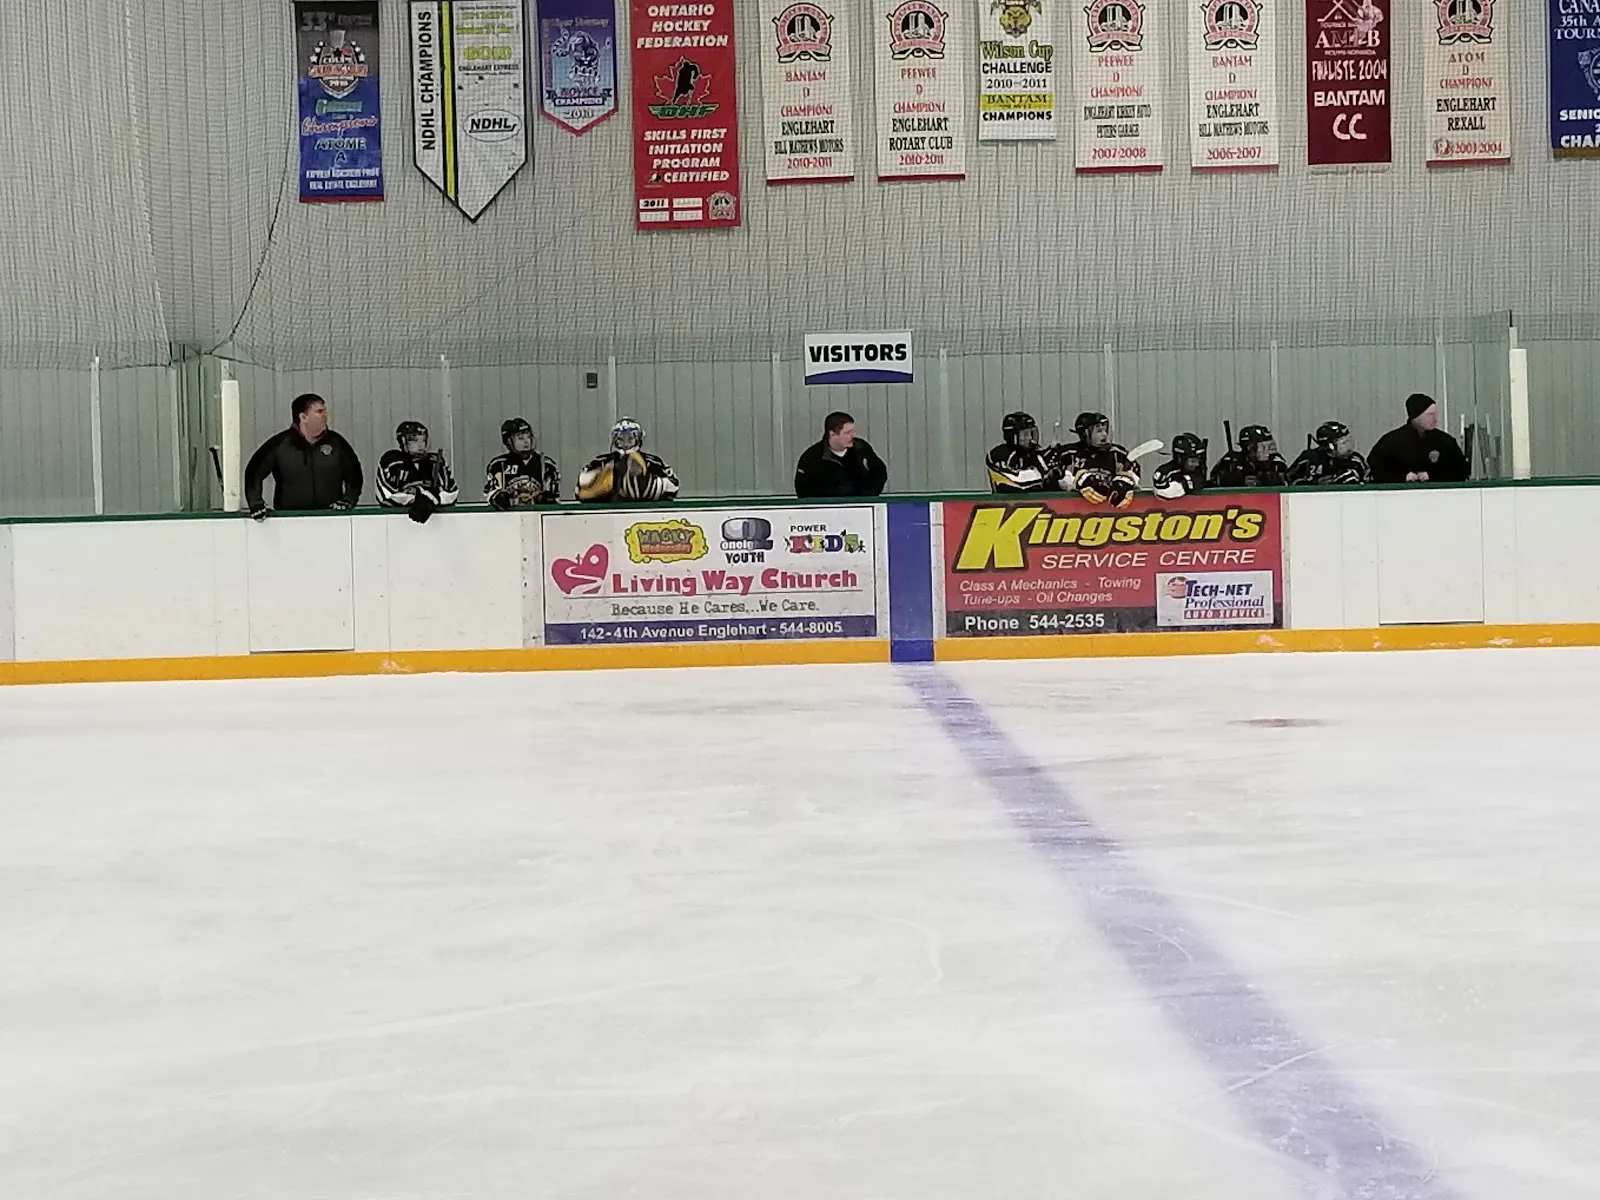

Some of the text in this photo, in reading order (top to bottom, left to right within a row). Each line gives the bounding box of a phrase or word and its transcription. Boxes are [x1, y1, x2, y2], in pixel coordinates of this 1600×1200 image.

[648, 4, 715, 17] ONTARIO
[651, 20, 712, 33] HOCKEY
[1560, 15, 1587, 27] 35th
[636, 35, 729, 49] FEDERATION
[980, 39, 1054, 61] Wilson Cup
[1098, 54, 1135, 67] PEEWEE
[1212, 55, 1252, 68] BANTAM
[1448, 52, 1485, 63] ATOM
[901, 67, 937, 79] PEEWEE
[982, 61, 1053, 74] CHALLENGE
[1311, 59, 1387, 81] FINALISTE 2004
[418, 11, 436, 151] NDHL CHAMPIONS
[785, 71, 826, 82] BANTAM
[915, 84, 924, 96] D
[987, 93, 1048, 104] BANTAM
[1313, 89, 1385, 107] BANTAM
[1435, 97, 1497, 112] ENGLEHART
[982, 111, 1053, 121] CHAMPIONS
[1206, 103, 1260, 118] ENGLEHART
[1560, 109, 1600, 121] SENIO
[469, 118, 517, 133] NDHL
[781, 120, 835, 135] ENGLEHART
[892, 117, 949, 132] ENGLEHART
[1332, 112, 1368, 140] CC
[1447, 115, 1487, 131] REXALL
[644, 128, 728, 141] SKILLS FIRST
[648, 143, 723, 155] INITIATION
[889, 136, 953, 151] ROTARY CLUB
[899, 153, 944, 165] 2010-2011
[1206, 146, 1262, 160] 2006-2007
[652, 157, 721, 169] PROGRAM
[787, 156, 833, 169] 2010-2011
[663, 171, 730, 183] CERTIFIED
[643, 200, 665, 208] 2011
[808, 343, 908, 362] VISITORS
[505, 464, 519, 475] 20
[1309, 464, 1324, 476] 24
[790, 524, 827, 532] POWER
[637, 528, 696, 544] WACKY
[955, 506, 1263, 571] Kingston's
[788, 533, 860, 554] KIDS
[725, 551, 765, 564] YOUTH
[1042, 549, 1256, 569] SERVICE CENTRE
[612, 567, 857, 597] Living Way Church
[960, 580, 994, 592] Class
[997, 580, 1007, 591] A
[1011, 578, 1078, 590] Mechanics
[1098, 576, 1141, 590] Towing
[1185, 580, 1253, 597] TECH-NET
[963, 593, 1020, 606] Tune-ups
[1036, 591, 1053, 603] Oil
[1057, 591, 1113, 604] Changes
[1185, 595, 1265, 609] Professional
[611, 603, 674, 616] Because
[679, 602, 699, 615] He
[782, 598, 820, 613] Care.
[1185, 608, 1264, 619] AUTO SERVICE
[965, 613, 1105, 630] Phone 544-2535
[580, 627, 638, 640] 142-4th
[641, 626, 694, 638] Avenue
[700, 624, 767, 639] Englehart
[780, 621, 842, 635] 544-8005
